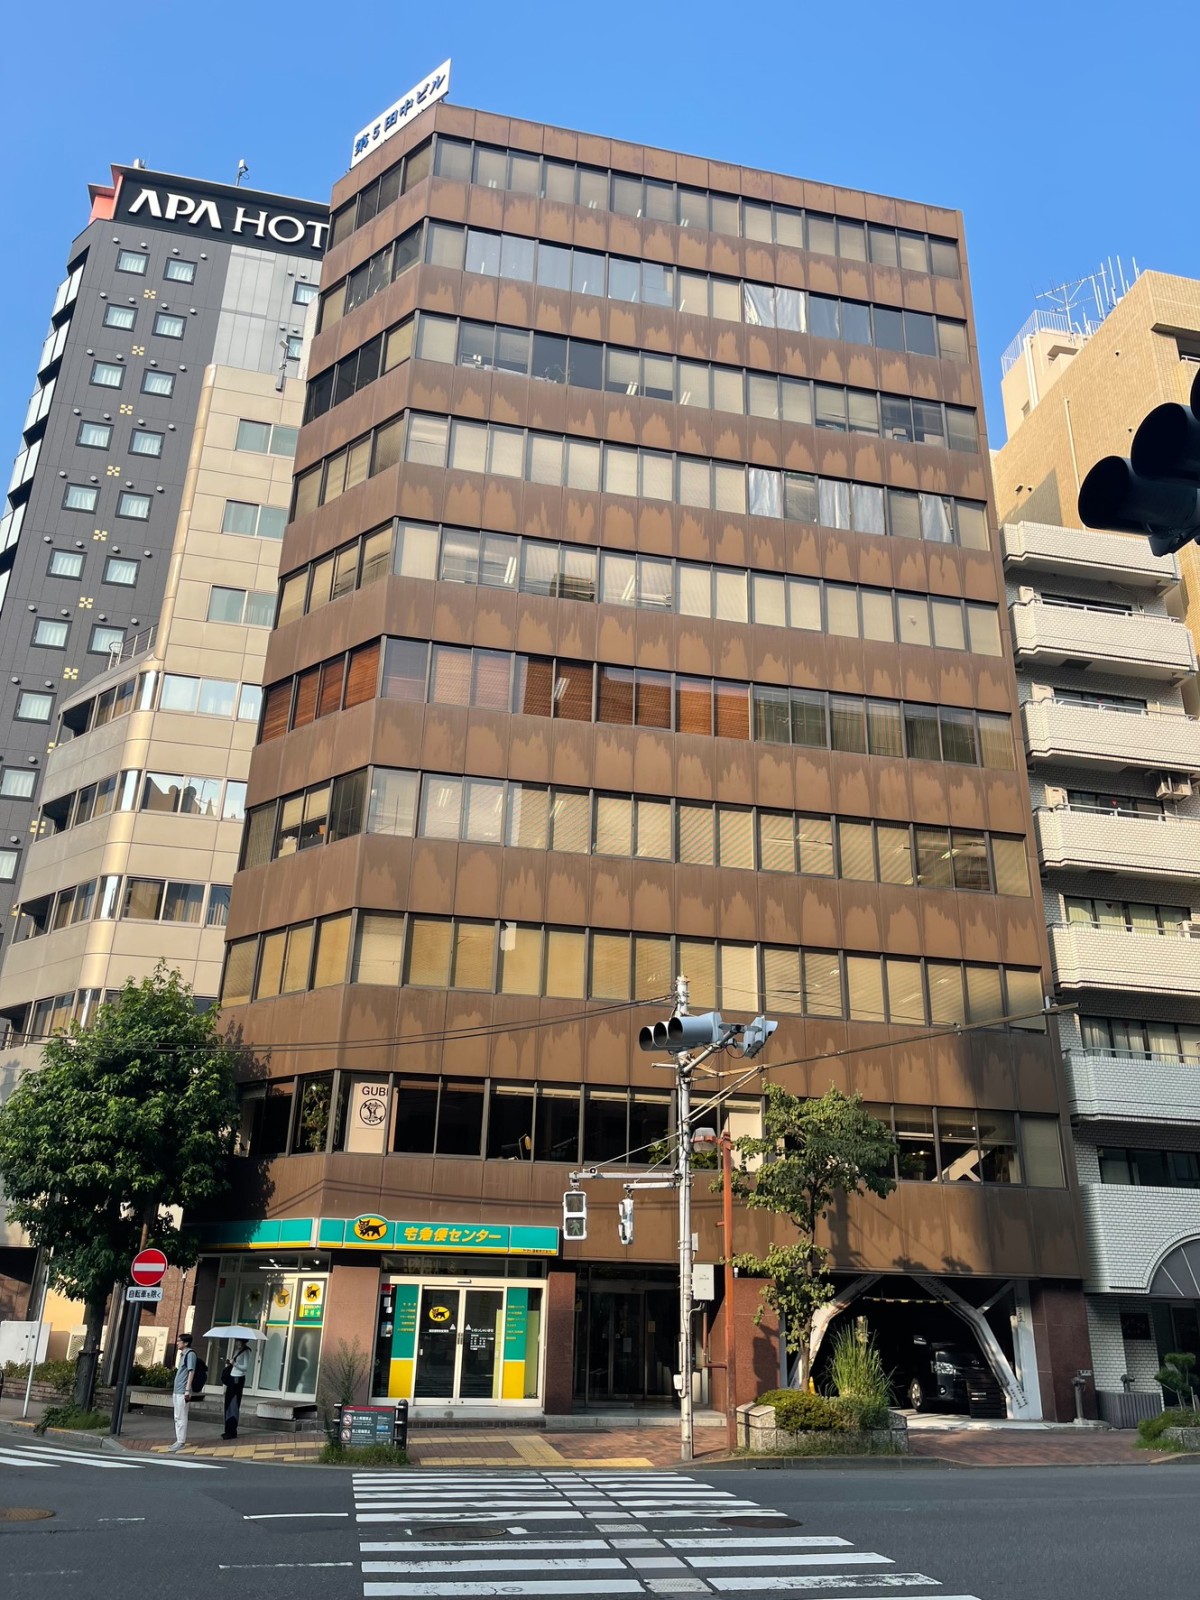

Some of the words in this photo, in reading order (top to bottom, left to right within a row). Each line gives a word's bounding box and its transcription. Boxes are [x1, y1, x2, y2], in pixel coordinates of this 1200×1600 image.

[354, 74, 446, 157] 第5田中ビル
[128, 188, 222, 230] APA
[404, 1226, 502, 1242] 宅急便センター
[128, 1289, 161, 1299] 自転車を除く
